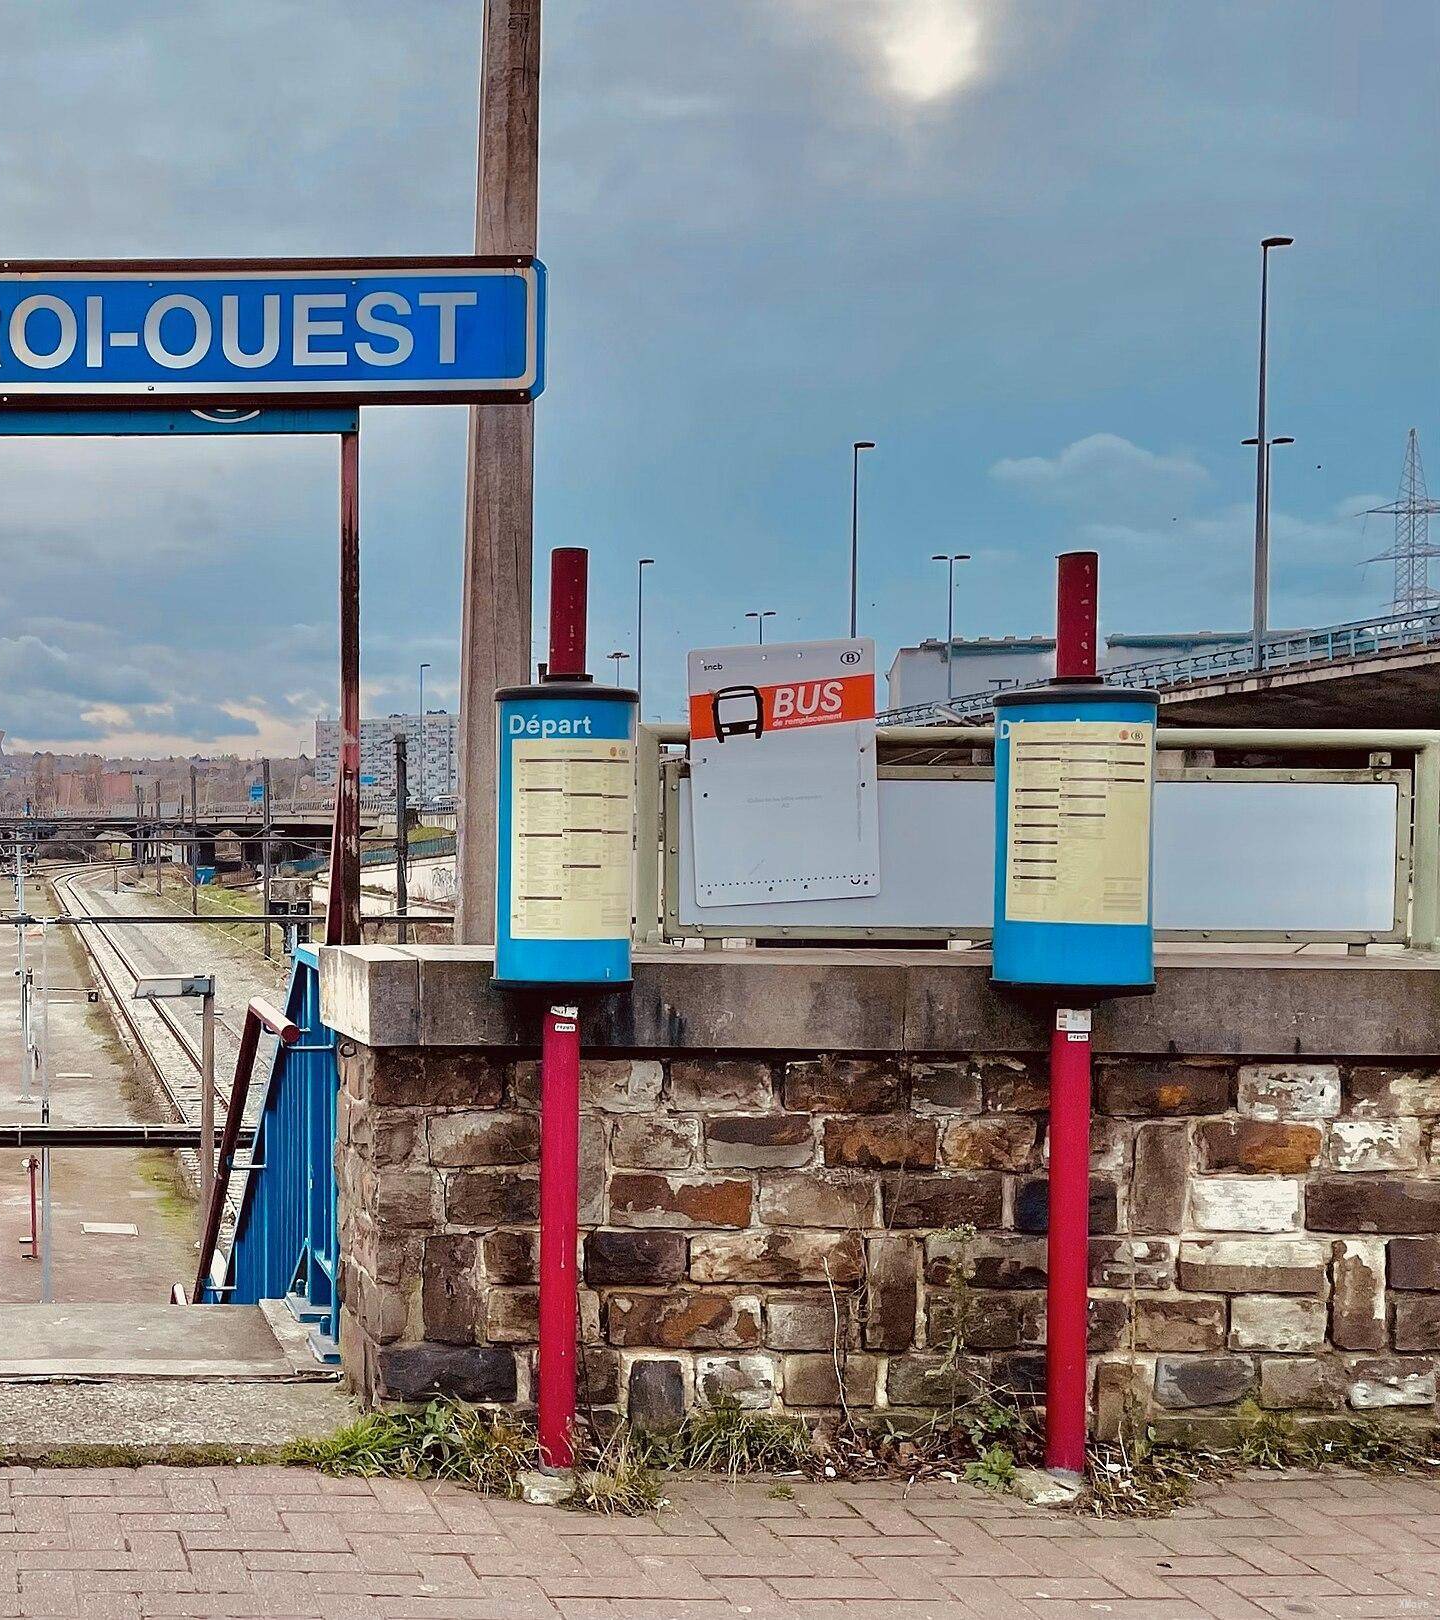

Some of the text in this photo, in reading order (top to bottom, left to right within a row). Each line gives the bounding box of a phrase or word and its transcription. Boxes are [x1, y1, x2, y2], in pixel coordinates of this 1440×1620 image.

[703, 663, 723, 671] sncb
[772, 681, 844, 719] BUS
[772, 719, 784, 727] de
[785, 712, 843, 726] remplacement
[509, 714, 592, 739] Départ
